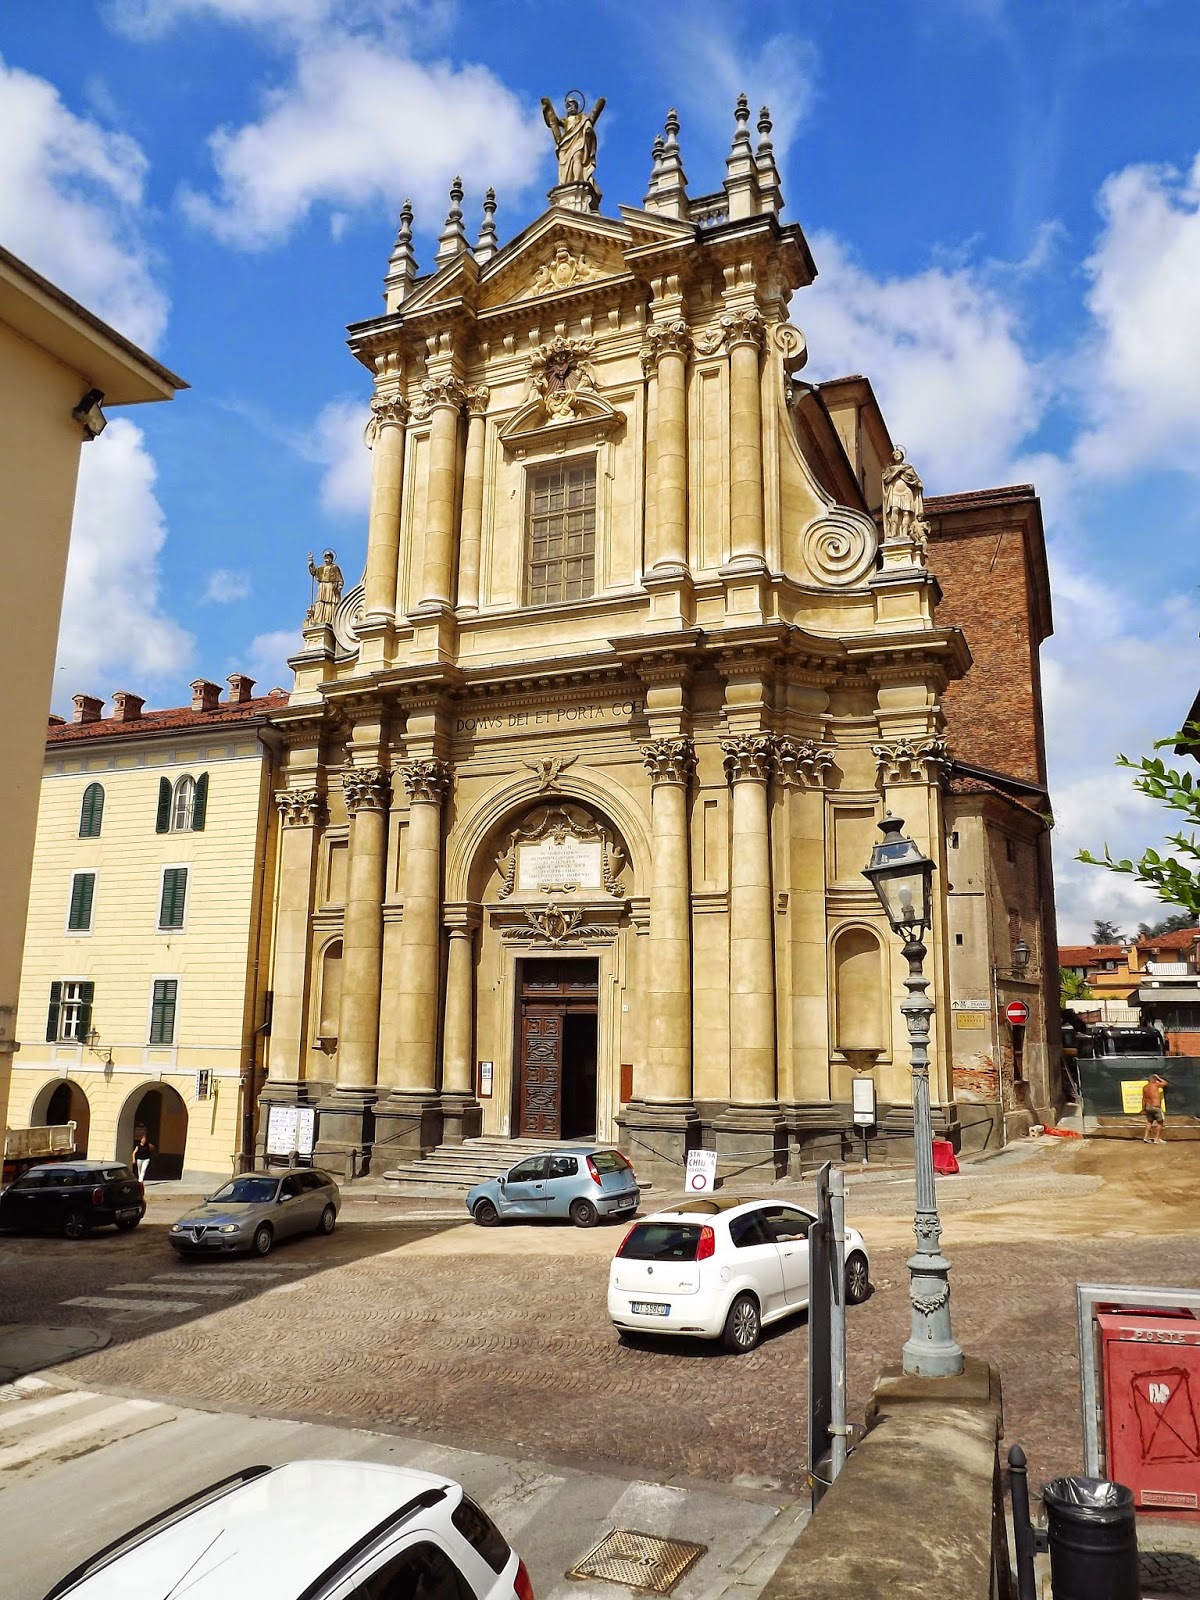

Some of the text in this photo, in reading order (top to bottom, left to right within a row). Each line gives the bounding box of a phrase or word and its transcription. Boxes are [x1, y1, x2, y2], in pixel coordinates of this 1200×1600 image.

[456, 715, 503, 732] DOMVS
[508, 713, 530, 727] DEI
[535, 710, 552, 724] ET
[556, 704, 605, 722] PORTA
[689, 1151, 716, 1159] STRDA
[688, 1159, 715, 1167] CHIUA
[1136, 1331, 1186, 1343] POSTE
